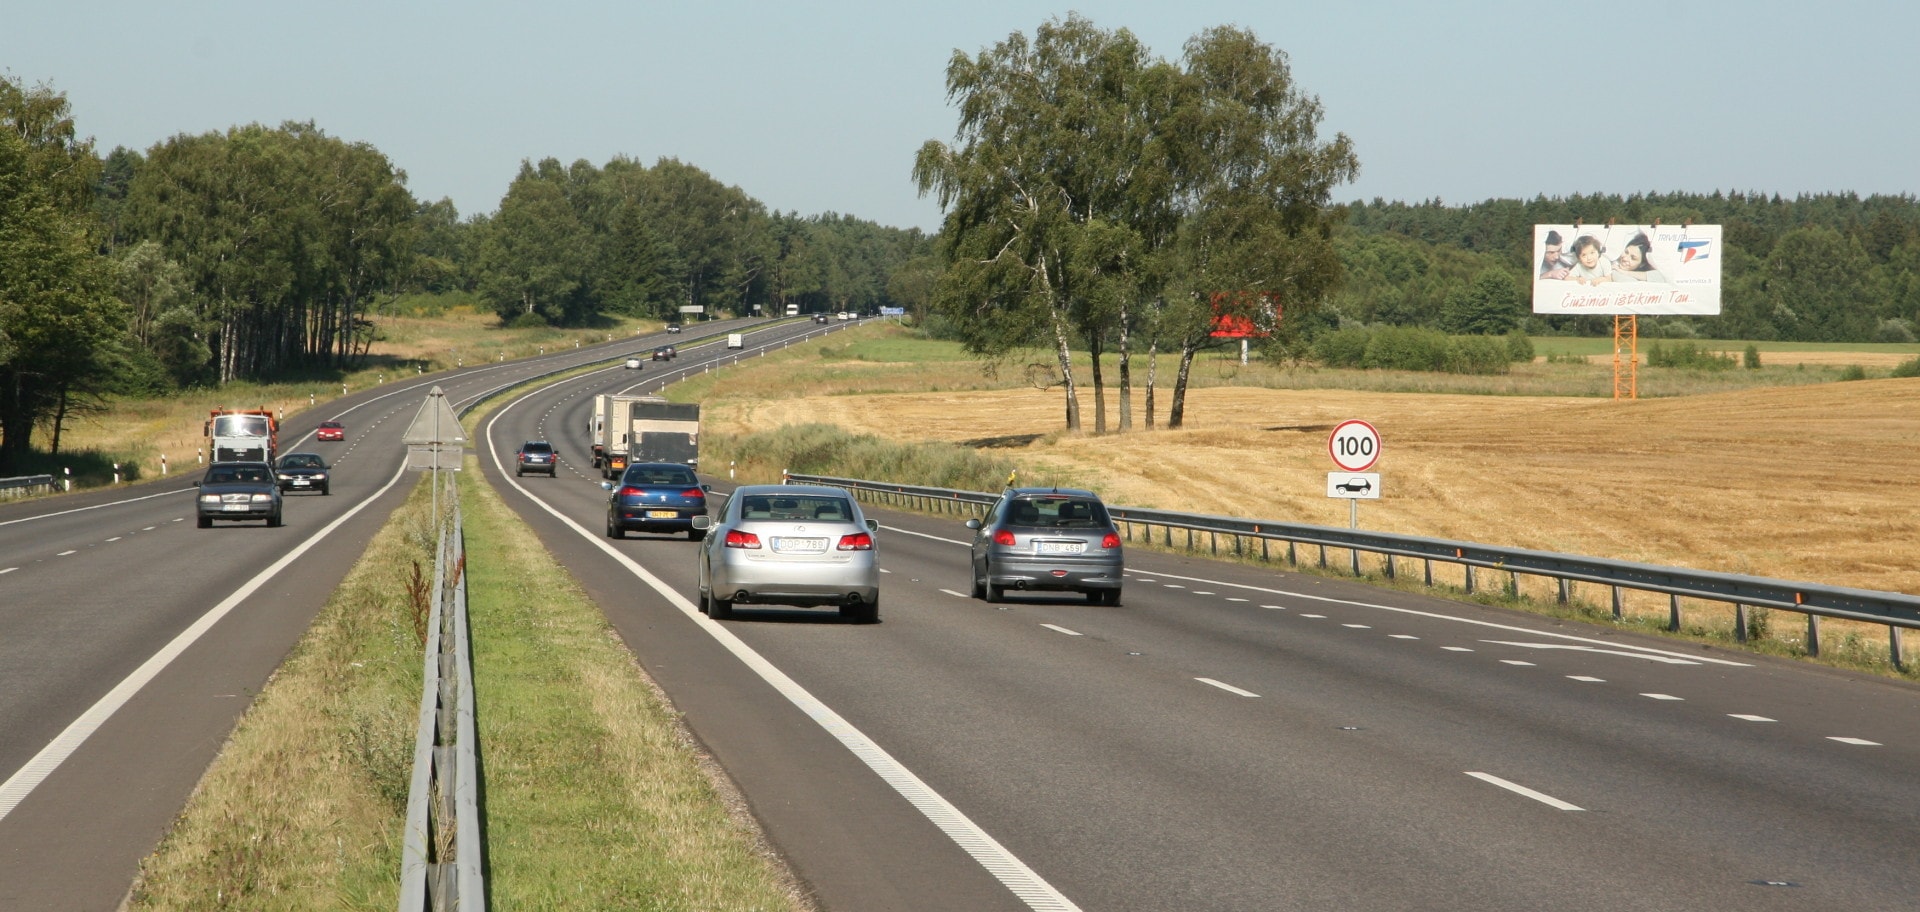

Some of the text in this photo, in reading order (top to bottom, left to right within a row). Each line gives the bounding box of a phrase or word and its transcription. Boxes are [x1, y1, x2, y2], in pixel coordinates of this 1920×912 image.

[1561, 292, 1611, 309] Čiužiniai
[1614, 292, 1664, 307] ištikimi
[1337, 436, 1373, 456] 100
